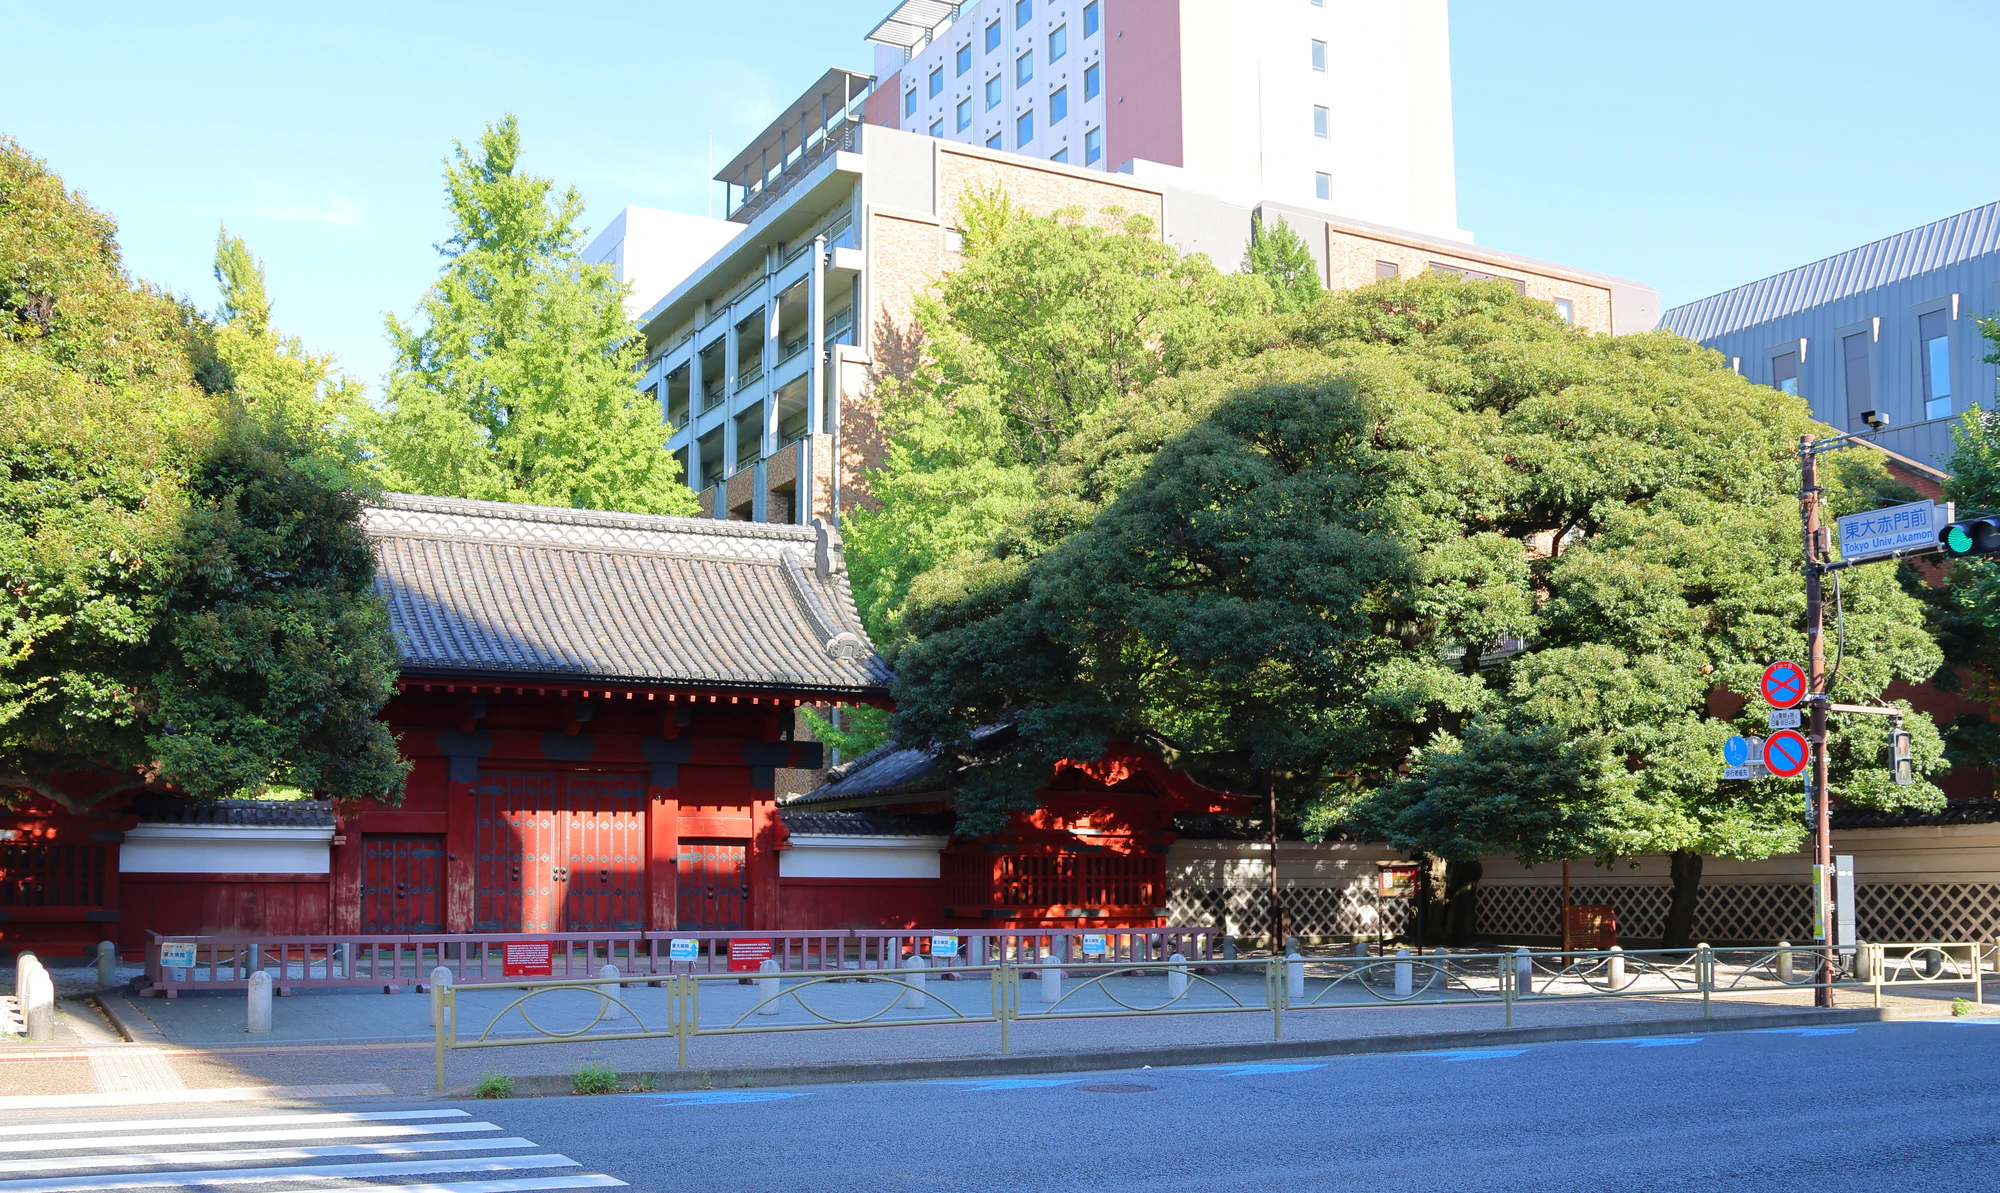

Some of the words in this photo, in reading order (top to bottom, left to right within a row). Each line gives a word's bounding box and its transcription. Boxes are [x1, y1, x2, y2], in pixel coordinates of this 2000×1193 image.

[1844, 508, 1927, 540] 東大赤門前
[1844, 541, 1869, 553] Tokyo
[1872, 537, 1895, 548] Univ.
[1896, 530, 1933, 544] Akamon
